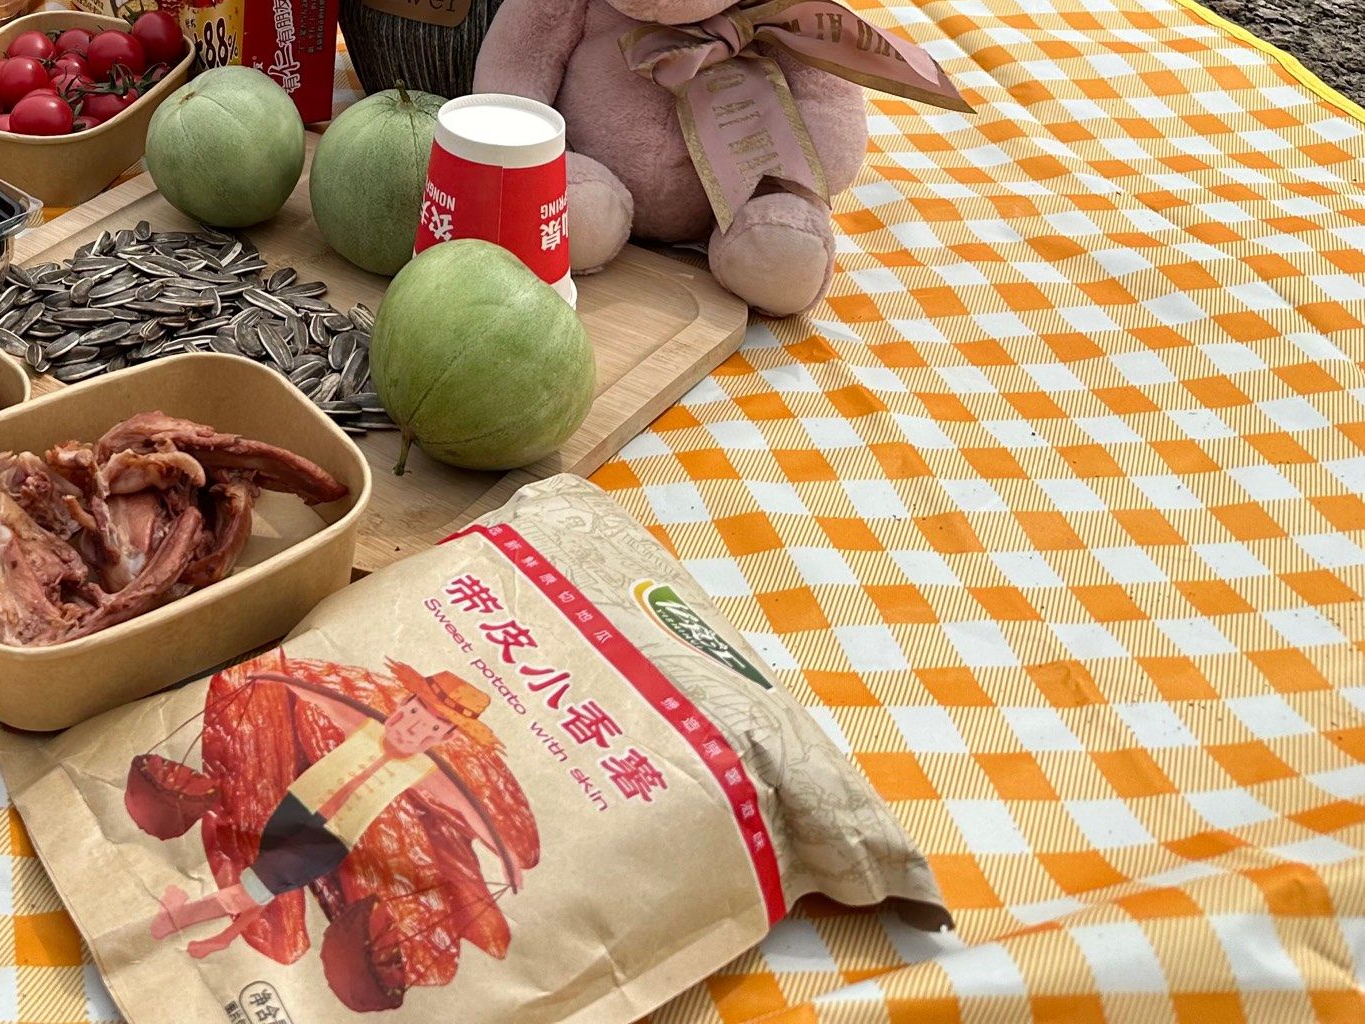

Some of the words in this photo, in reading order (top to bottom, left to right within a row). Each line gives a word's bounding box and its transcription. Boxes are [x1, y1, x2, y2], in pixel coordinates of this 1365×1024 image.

[424, 598, 474, 654] Sweet
[470, 658, 527, 716] potato
[529, 721, 569, 763] with
[569, 767, 609, 812] skin
[445, 574, 668, 803] 带皮小香薯
